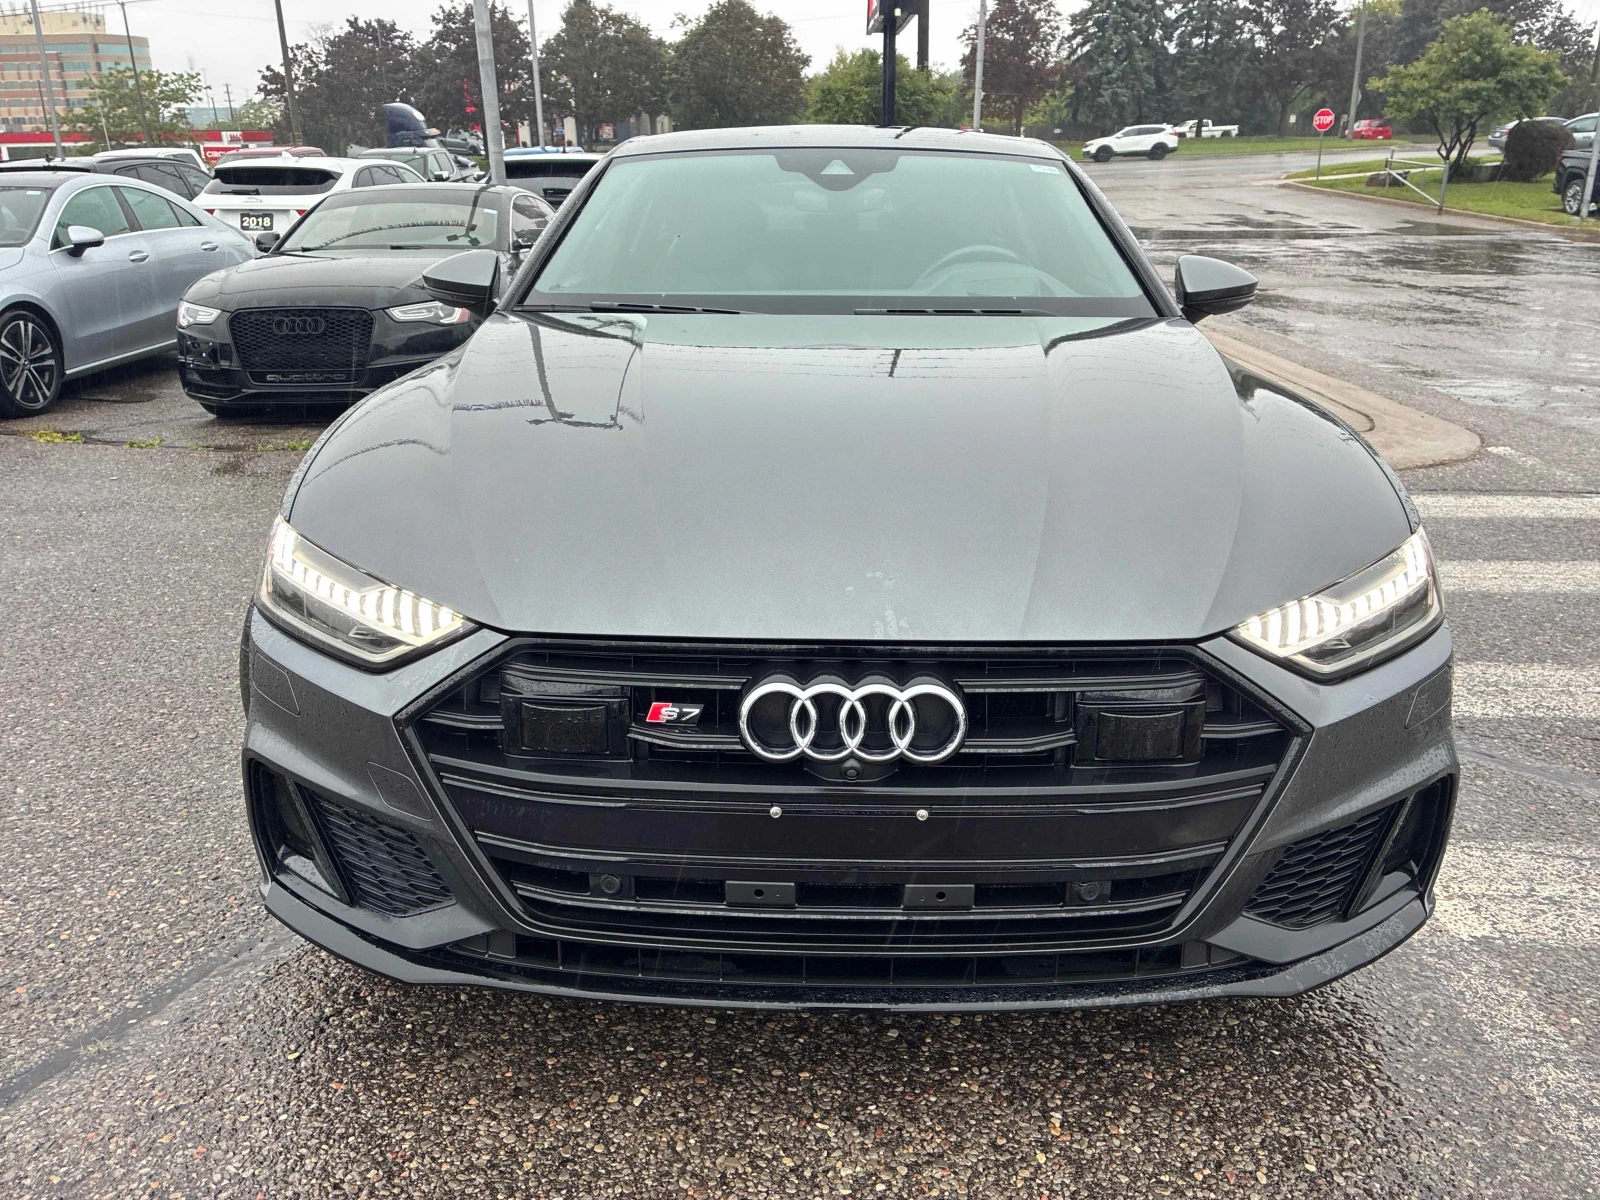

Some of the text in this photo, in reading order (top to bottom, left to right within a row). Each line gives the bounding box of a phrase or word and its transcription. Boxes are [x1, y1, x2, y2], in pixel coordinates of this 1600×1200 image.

[1315, 115, 1333, 125] STOP
[242, 216, 271, 227] 2018
[266, 372, 347, 382] quattro
[658, 707, 700, 721] S7
